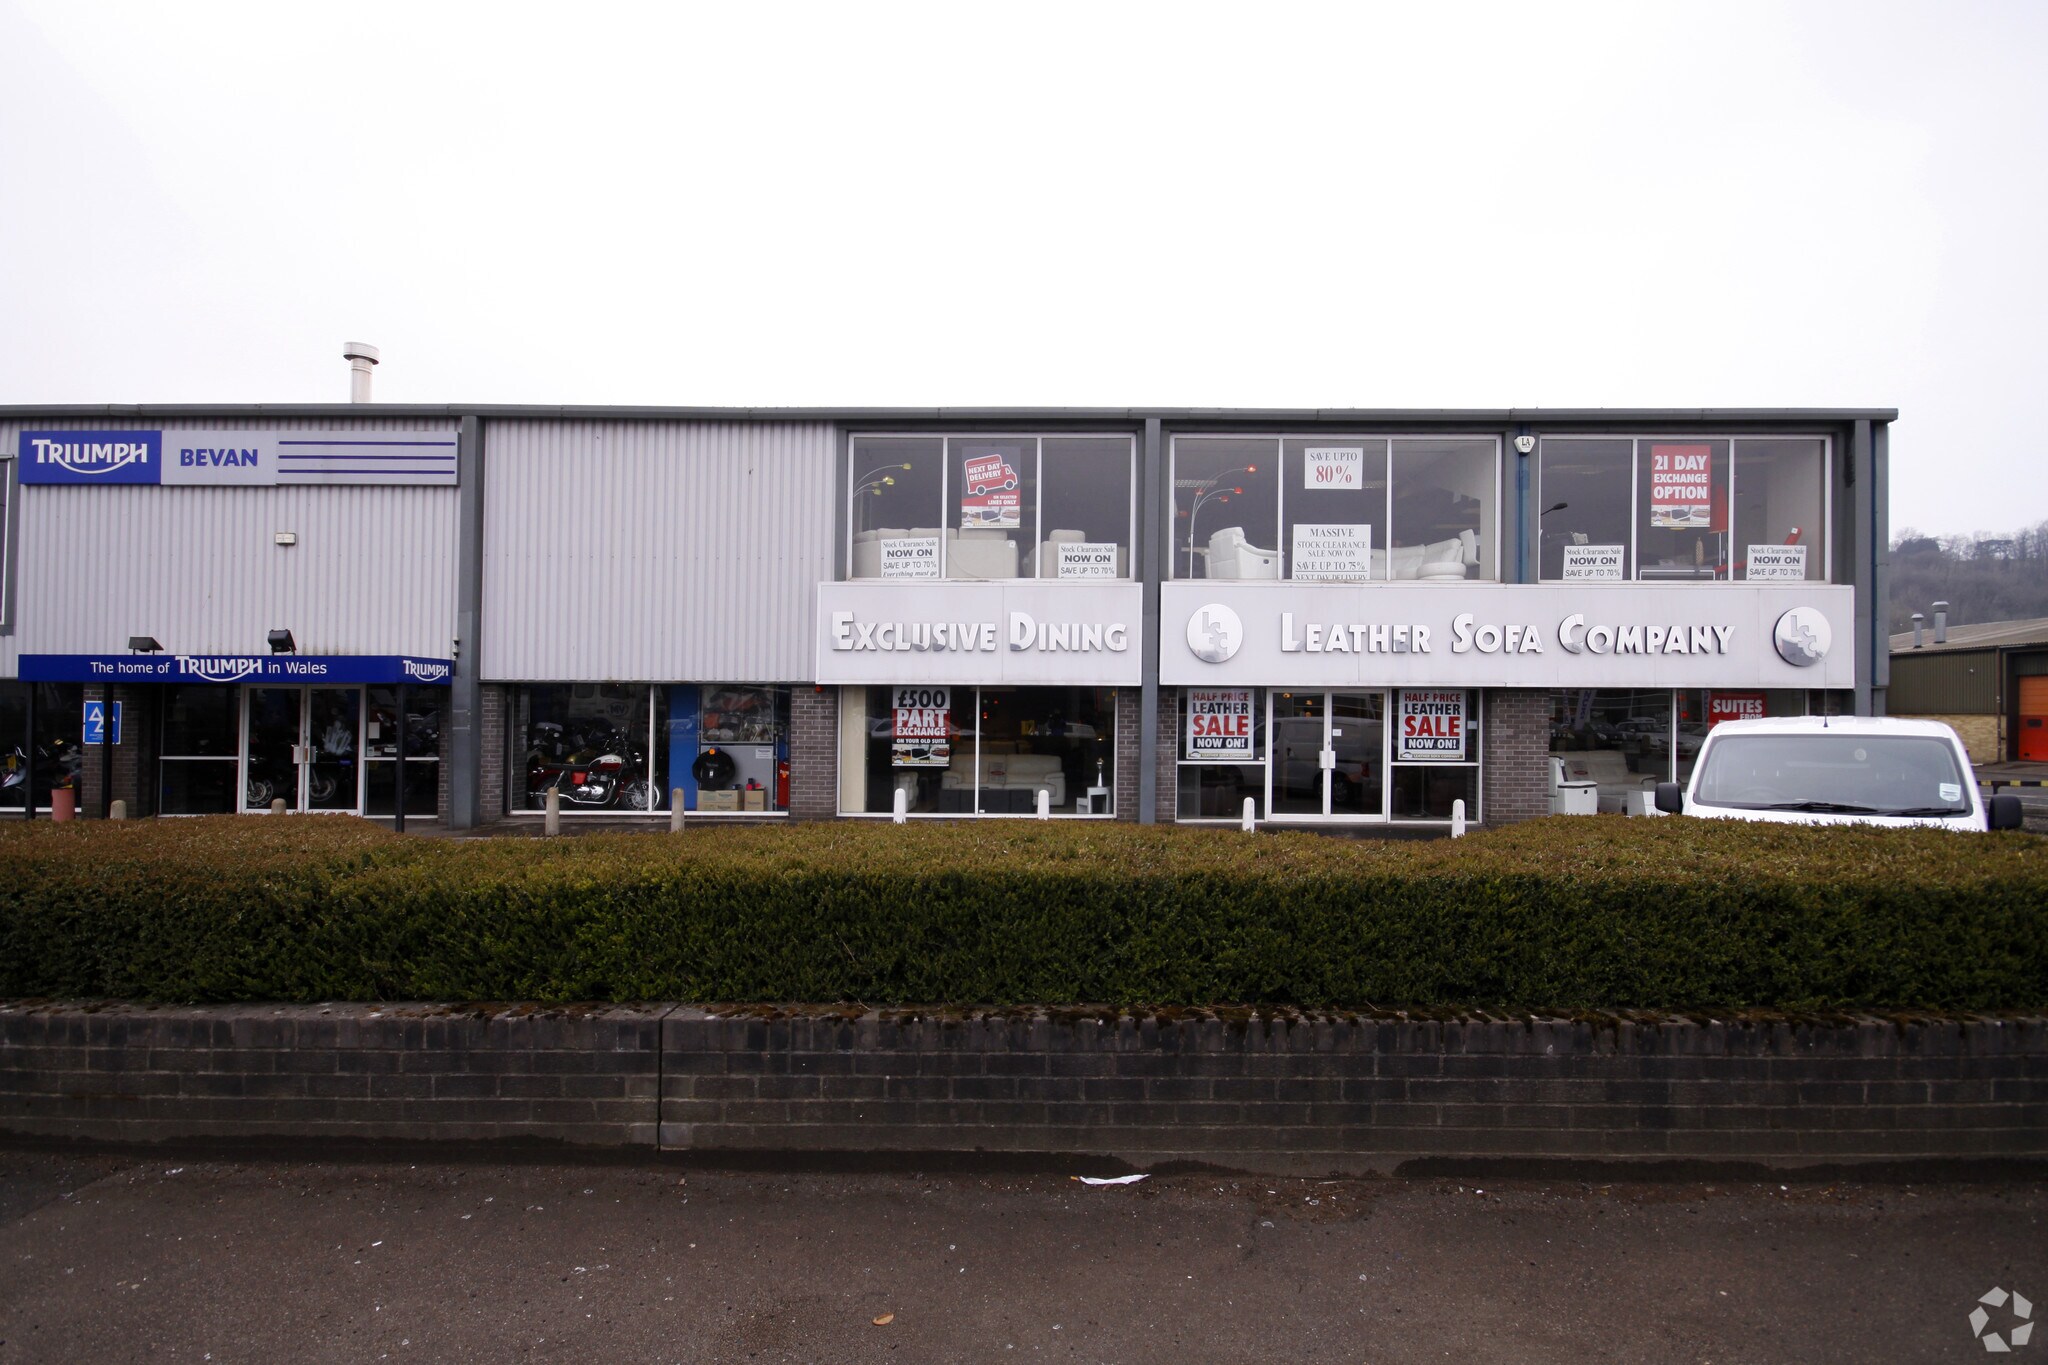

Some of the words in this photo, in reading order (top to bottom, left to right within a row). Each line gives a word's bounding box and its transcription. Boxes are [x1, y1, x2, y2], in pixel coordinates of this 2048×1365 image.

[32, 439, 147, 473] TRIUMPH
[180, 449, 258, 467] BEVAN
[1310, 452, 1330, 461] SAVE
[1654, 455, 1668, 470] 21
[1674, 455, 1708, 470] DAY
[968, 465, 986, 474] NEXT
[987, 463, 1000, 471] DAY
[1316, 465, 1352, 483] 80%
[969, 469, 1002, 482] DELIVERY
[1654, 474, 1708, 483] EXCHANGE
[1654, 486, 1708, 499] OPTION
[1310, 528, 1354, 537] MASSIVE
[886, 550, 914, 558] NOW
[916, 548, 932, 556] ON
[1064, 554, 1091, 562] NOW
[1094, 554, 1110, 562] ON
[1784, 556, 1800, 564] ON
[1296, 562, 1316, 570] SAVE
[1320, 562, 1331, 570] UP
[1334, 562, 1346, 570] TO
[1348, 562, 1366, 570] 75%
[90, 662, 114, 674] The
[118, 662, 154, 674] home
[158, 662, 170, 674] of
[175, 656, 262, 682] TRIUMPH
[268, 662, 280, 674] in
[286, 662, 327, 674] Wales
[403, 660, 449, 681] TRIUMPH
[898, 690, 946, 708] £500
[1193, 692, 1217, 701] HALF
[1221, 692, 1248, 701] PRICE
[1404, 693, 1429, 702] HALF
[1433, 693, 1460, 702] PRICE
[1193, 702, 1248, 714] LEATHER
[1404, 704, 1460, 715] LEATHER
[1712, 700, 1763, 713] SUITES
[896, 710, 948, 728] PART
[1193, 714, 1248, 736] SALE
[1404, 716, 1460, 736] SALE
[896, 728, 946, 736] EXCHANGE
[1197, 738, 1222, 748] NOW
[1226, 738, 1245, 748] ON!
[1408, 739, 1434, 748] NOW
[1437, 740, 1456, 749] ON!
